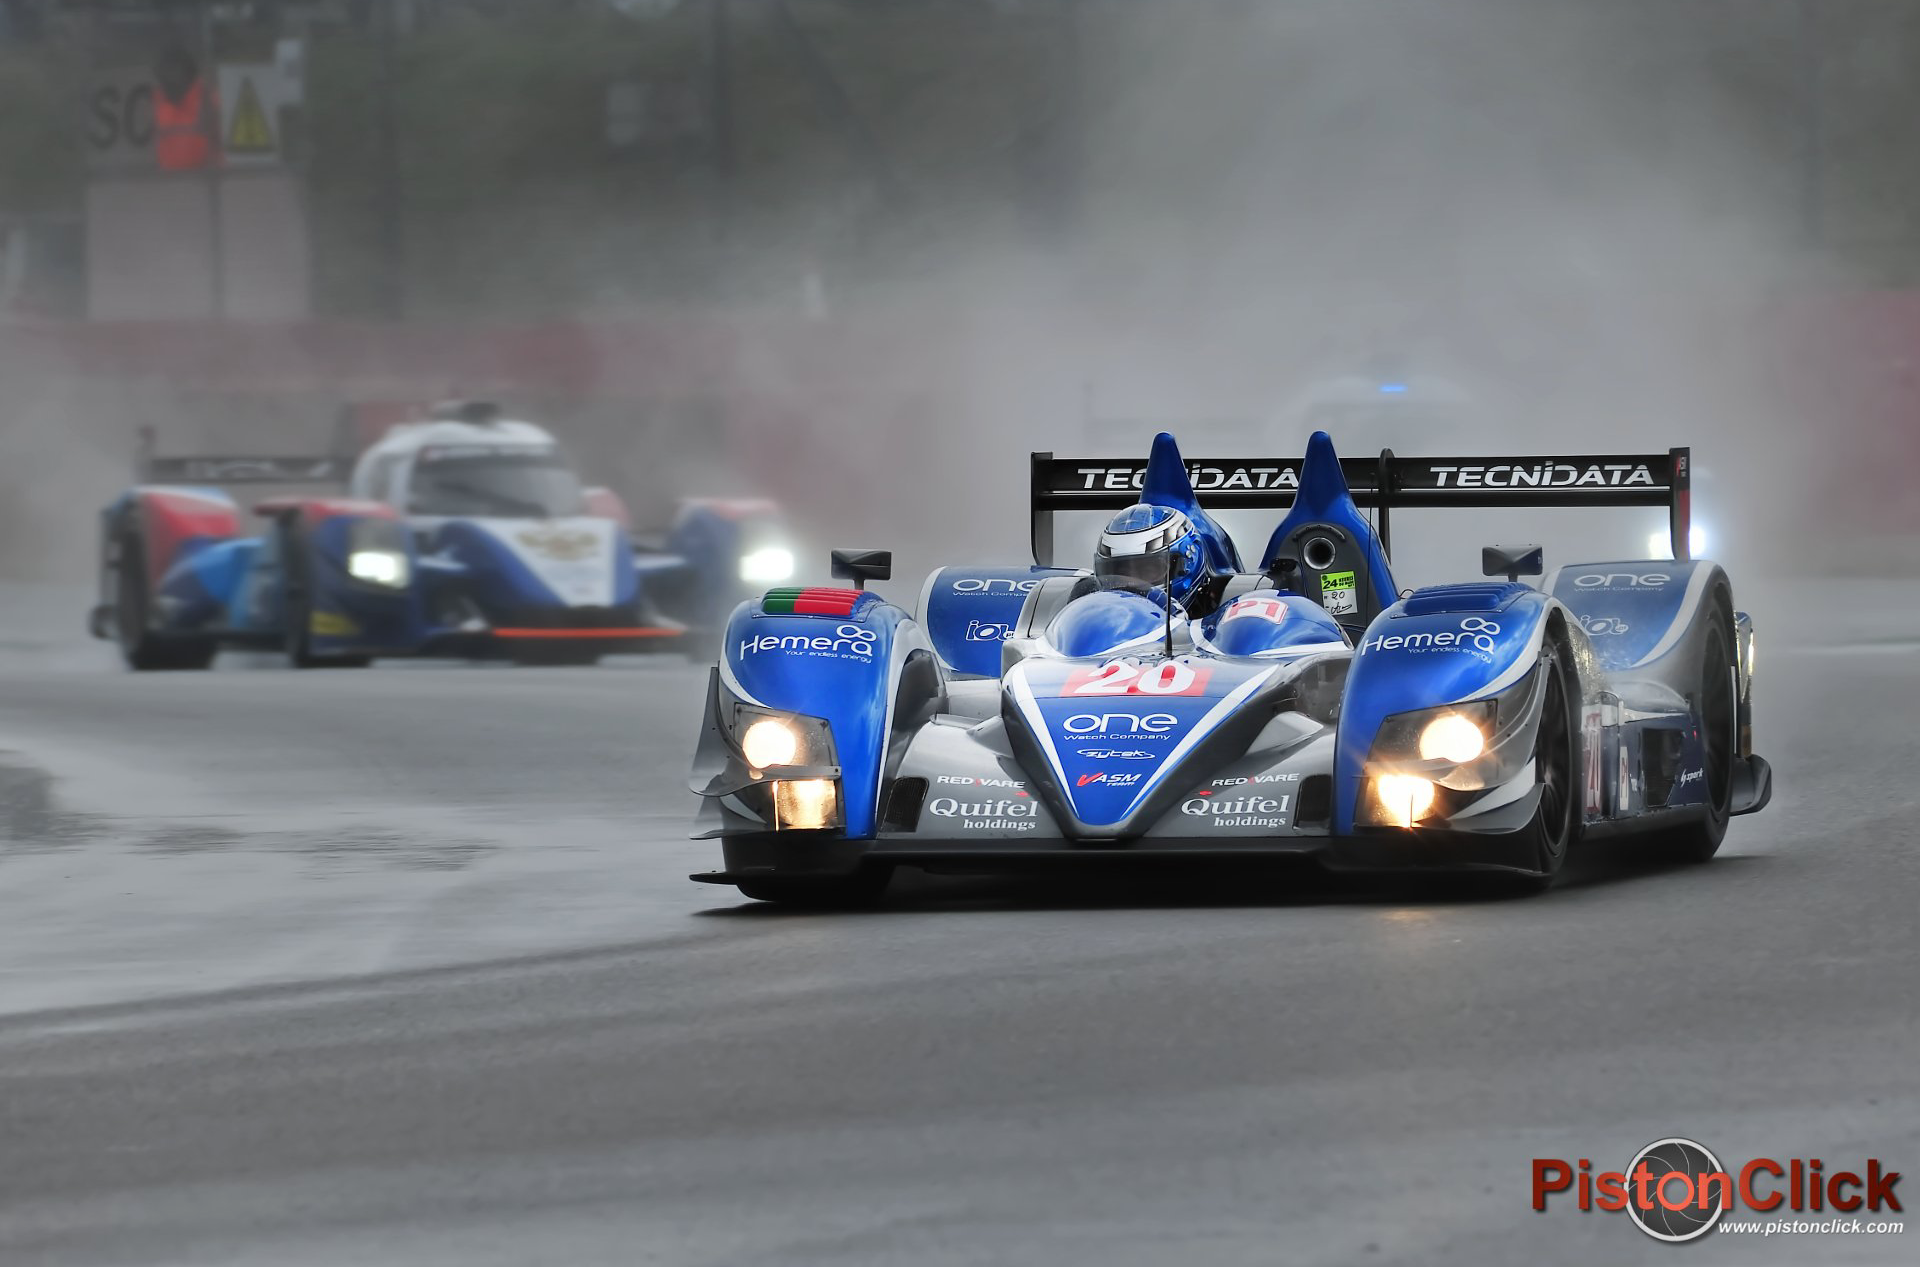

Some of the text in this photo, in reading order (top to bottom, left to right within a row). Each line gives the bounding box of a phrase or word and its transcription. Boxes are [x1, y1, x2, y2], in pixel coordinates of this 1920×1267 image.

[1429, 461, 1655, 487] TECNIDATA
[1323, 579, 1338, 589] 24
[1573, 573, 1671, 587] one
[739, 634, 873, 661] Hemera
[1361, 632, 1495, 656] Hemera
[841, 653, 872, 664] energy
[1462, 648, 1492, 664] energy
[1073, 659, 1196, 694] 20
[1062, 713, 1178, 733] one
[929, 797, 1039, 817] Quifel
[1181, 795, 1290, 816] Quifel
[963, 819, 1036, 831] holdings
[1214, 816, 1286, 828] holdings
